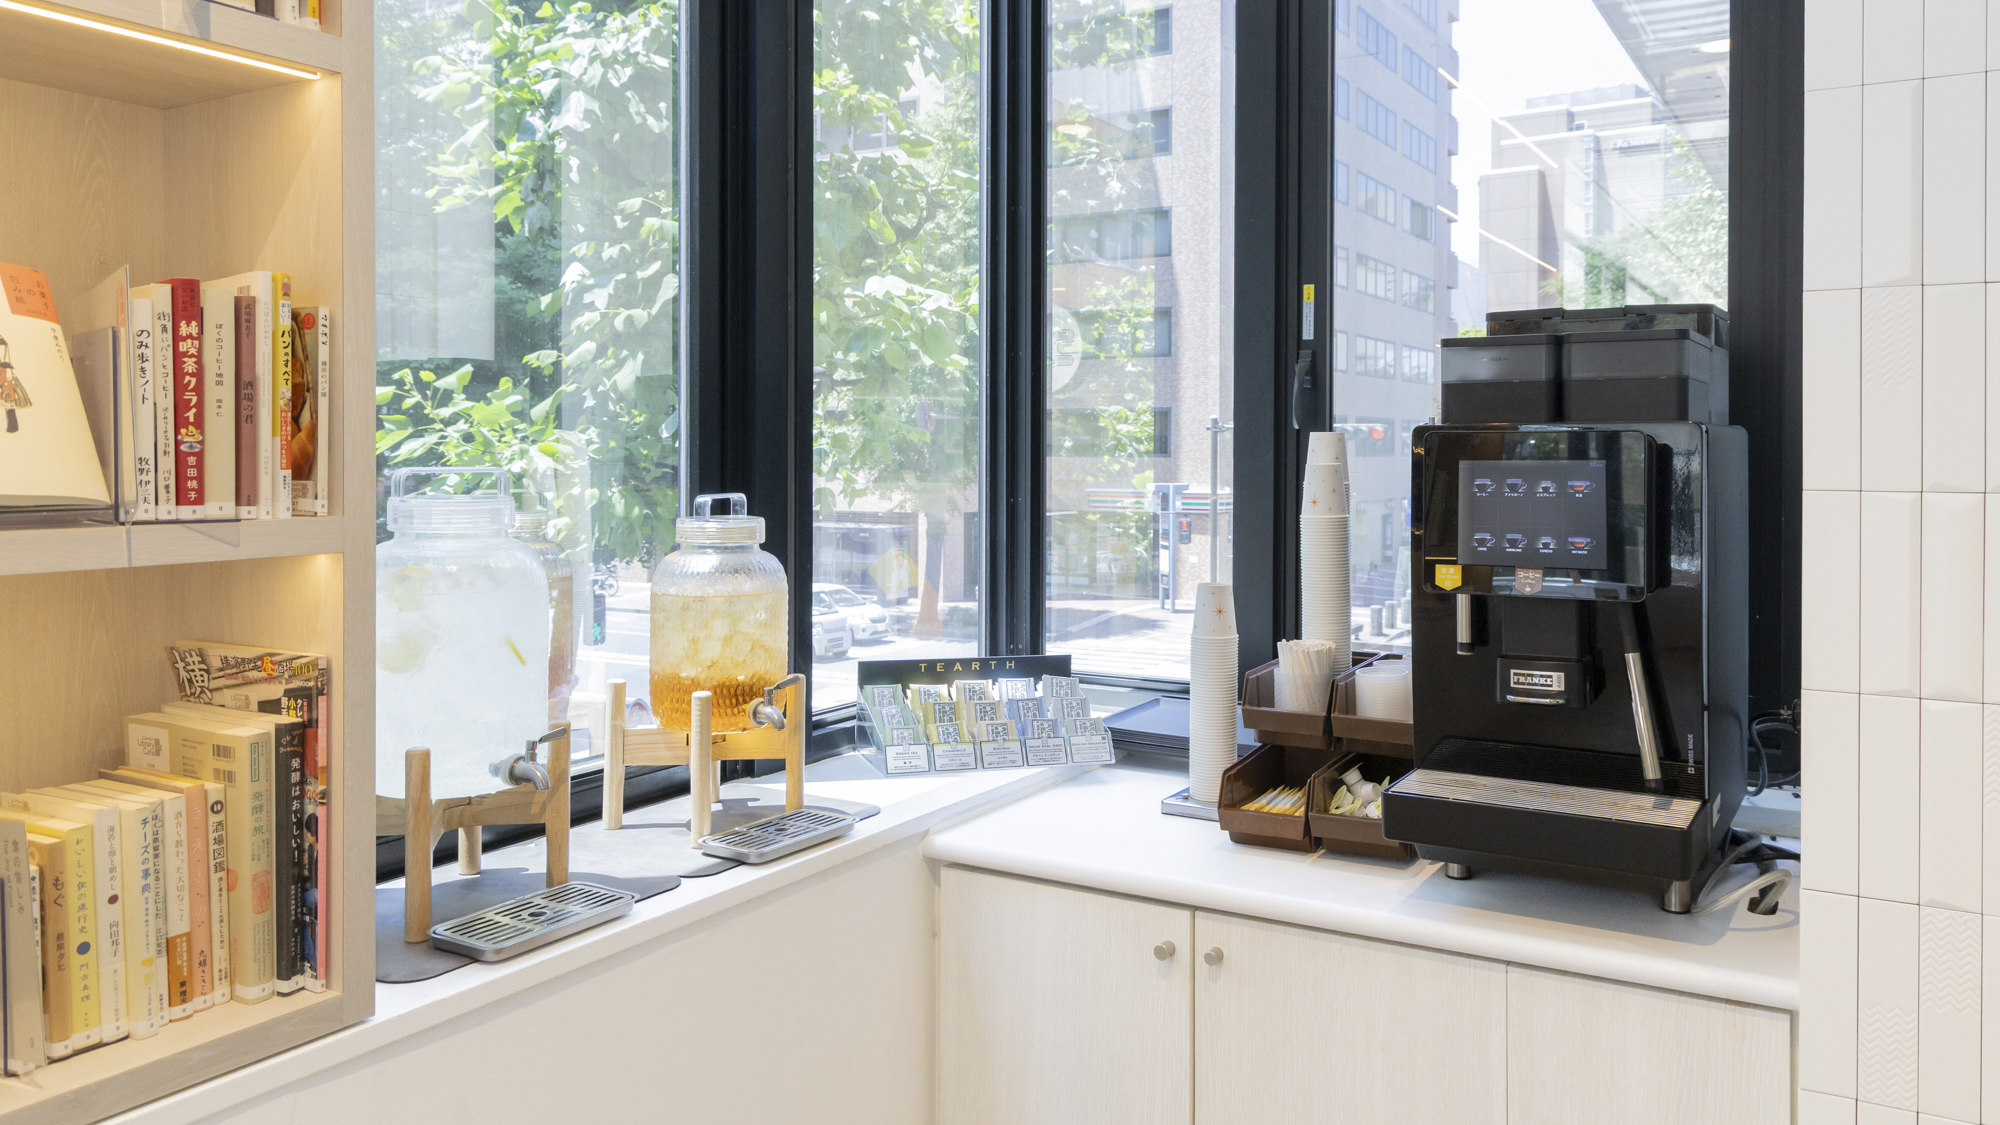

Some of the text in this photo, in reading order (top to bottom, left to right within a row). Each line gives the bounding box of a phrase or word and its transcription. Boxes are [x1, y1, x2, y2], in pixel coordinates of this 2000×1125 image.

[26, 288, 36, 297] の
[136, 329, 151, 405] のみ歩きノート
[156, 311, 171, 399] 街角にパンとコーヒー
[179, 320, 199, 423] 純喫茶クライ
[215, 323, 224, 387] ぼくのコーヒー地図
[280, 330, 292, 386] パンのすべて
[242, 380, 254, 425] 酒場の君
[137, 456, 151, 505] 牧野伊三夫
[186, 456, 198, 501] 吉田桃子
[172, 649, 213, 700] 横
[919, 660, 1015, 673] TEARTH
[1513, 675, 1553, 685] FRANKE
[251, 791, 265, 838] 発酵の旅
[291, 757, 301, 862] 発酵はおいしい！
[106, 824, 117, 890] 海苔と卵と朝めし
[140, 817, 152, 896] チーズの事典
[212, 820, 226, 875] 酒場図鑑
[52, 876, 65, 908] もぐ
[109, 921, 120, 957] 向田邦子
